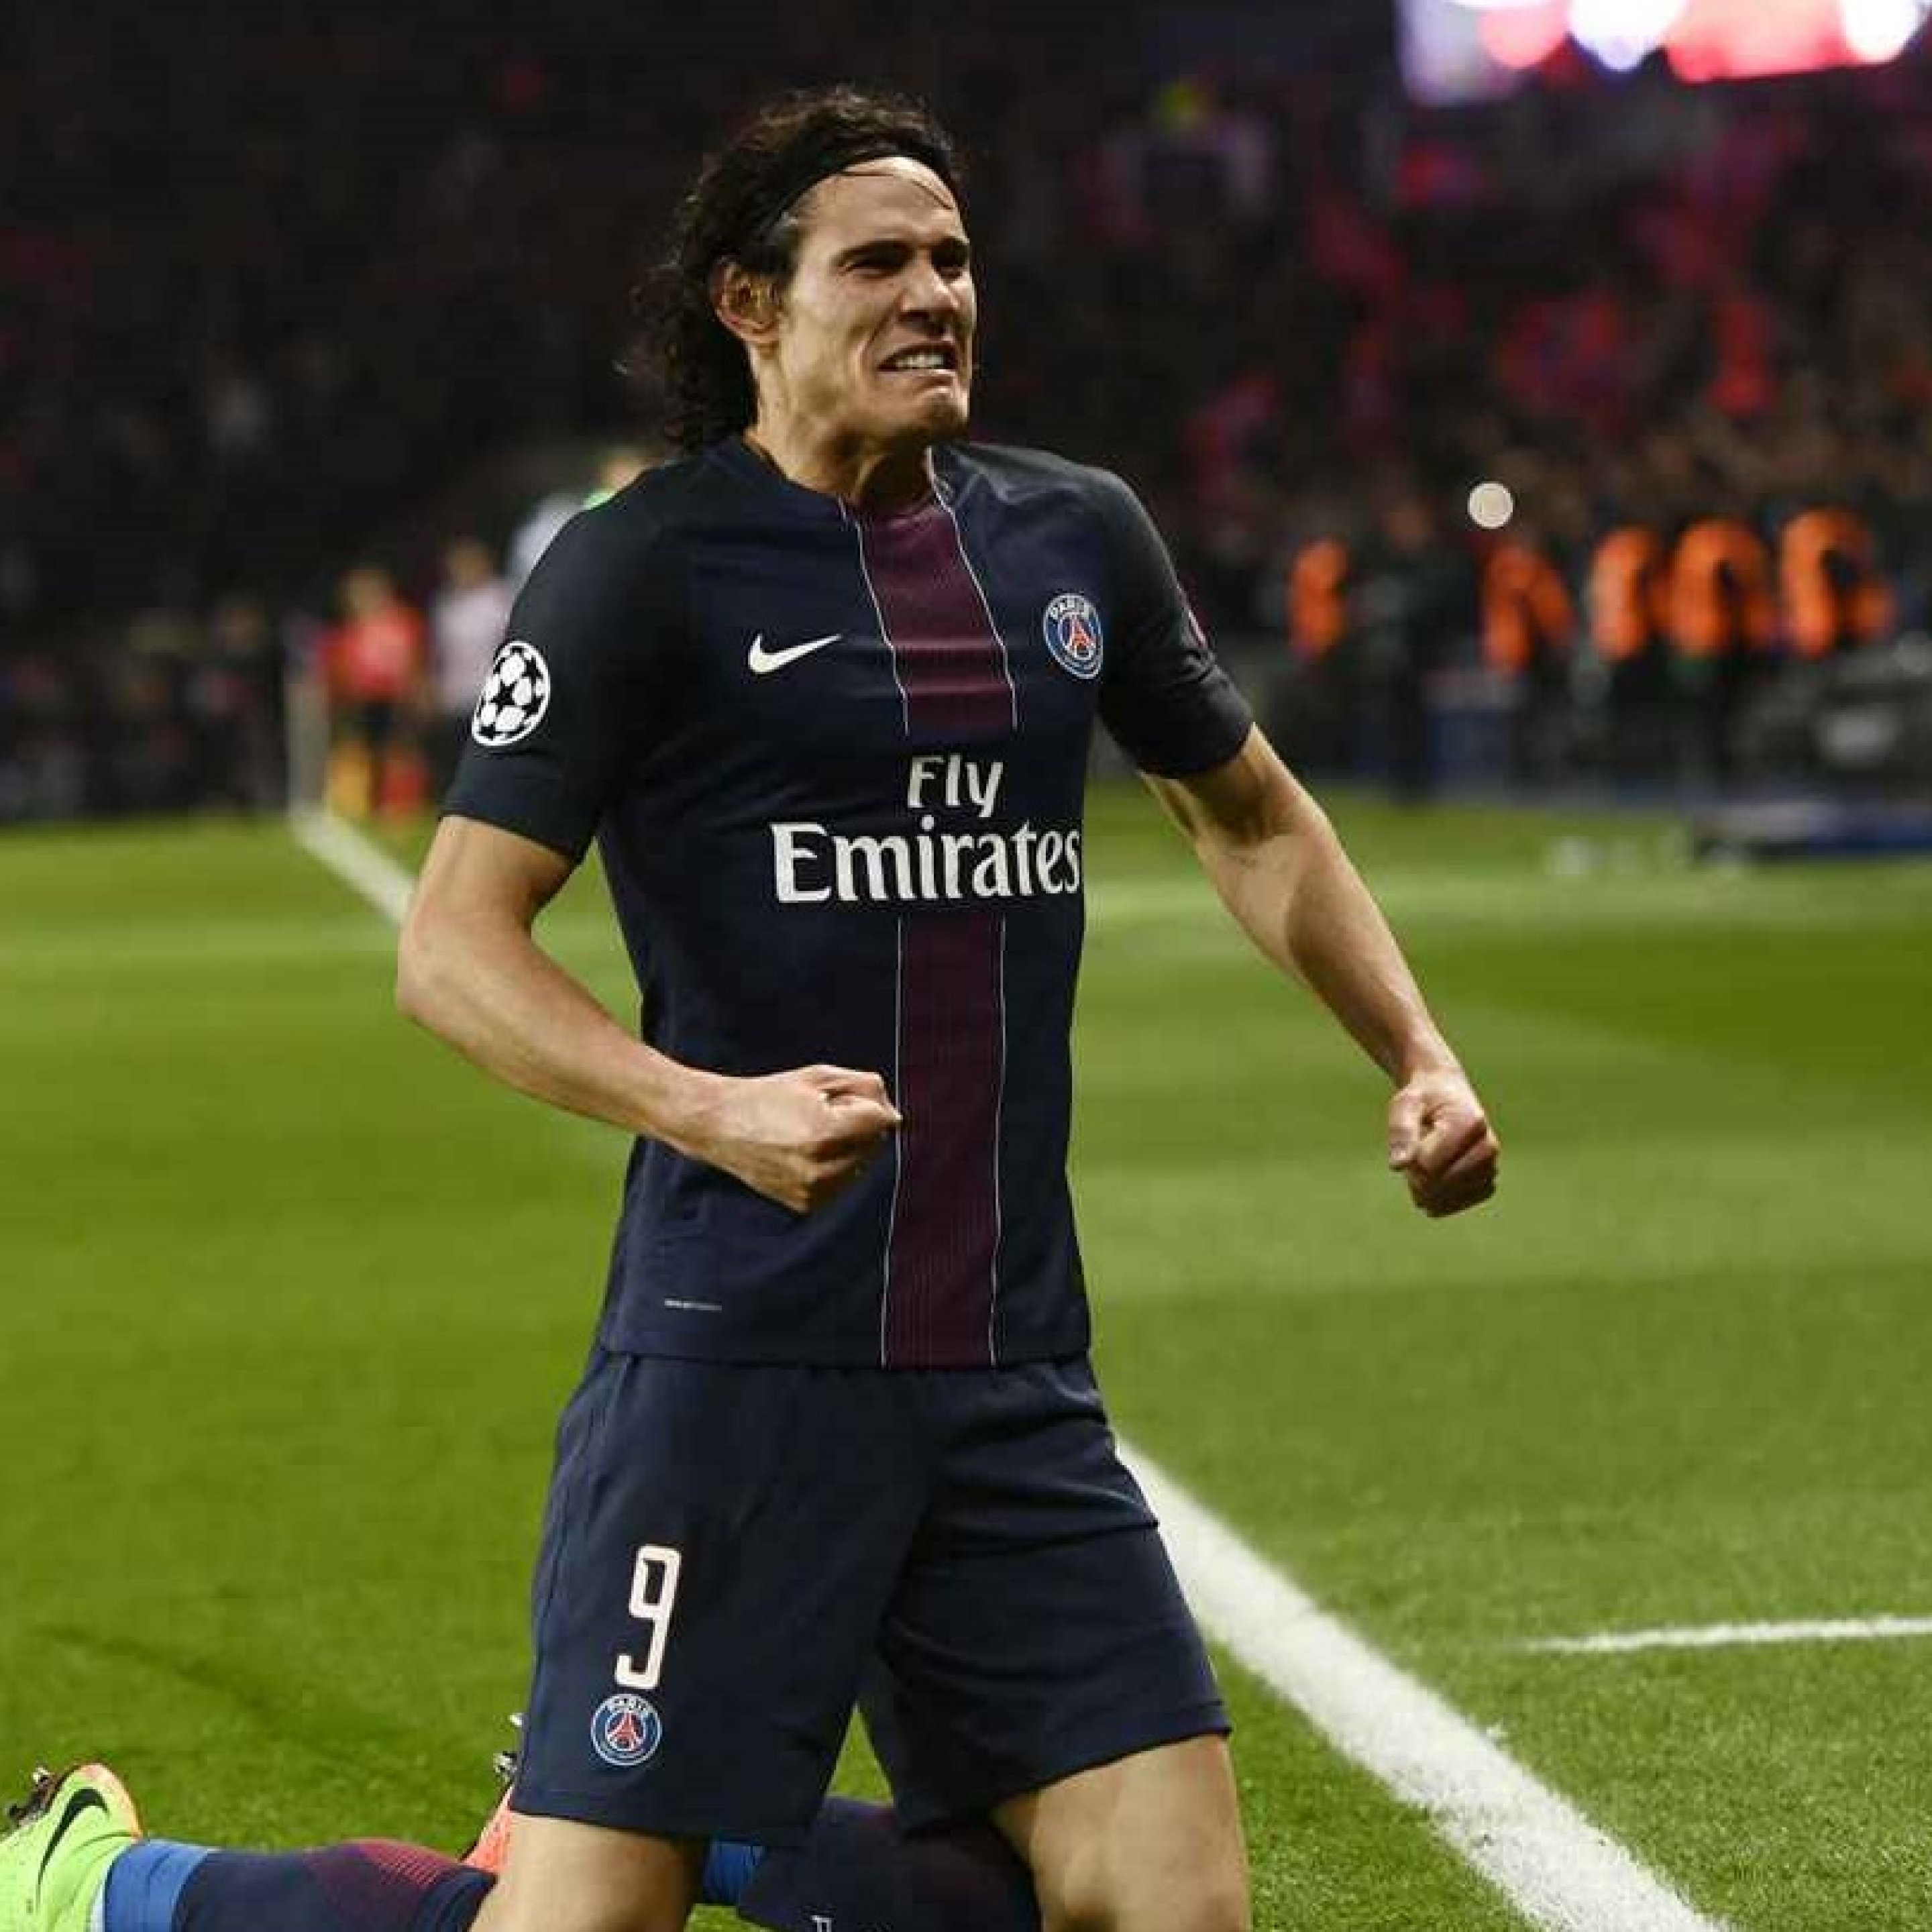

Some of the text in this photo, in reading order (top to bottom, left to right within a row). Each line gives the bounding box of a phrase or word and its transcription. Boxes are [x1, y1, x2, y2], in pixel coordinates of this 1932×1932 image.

[908, 753, 1004, 818] Fly
[771, 814, 1081, 903] Emirates
[614, 1544, 681, 1688] 9
